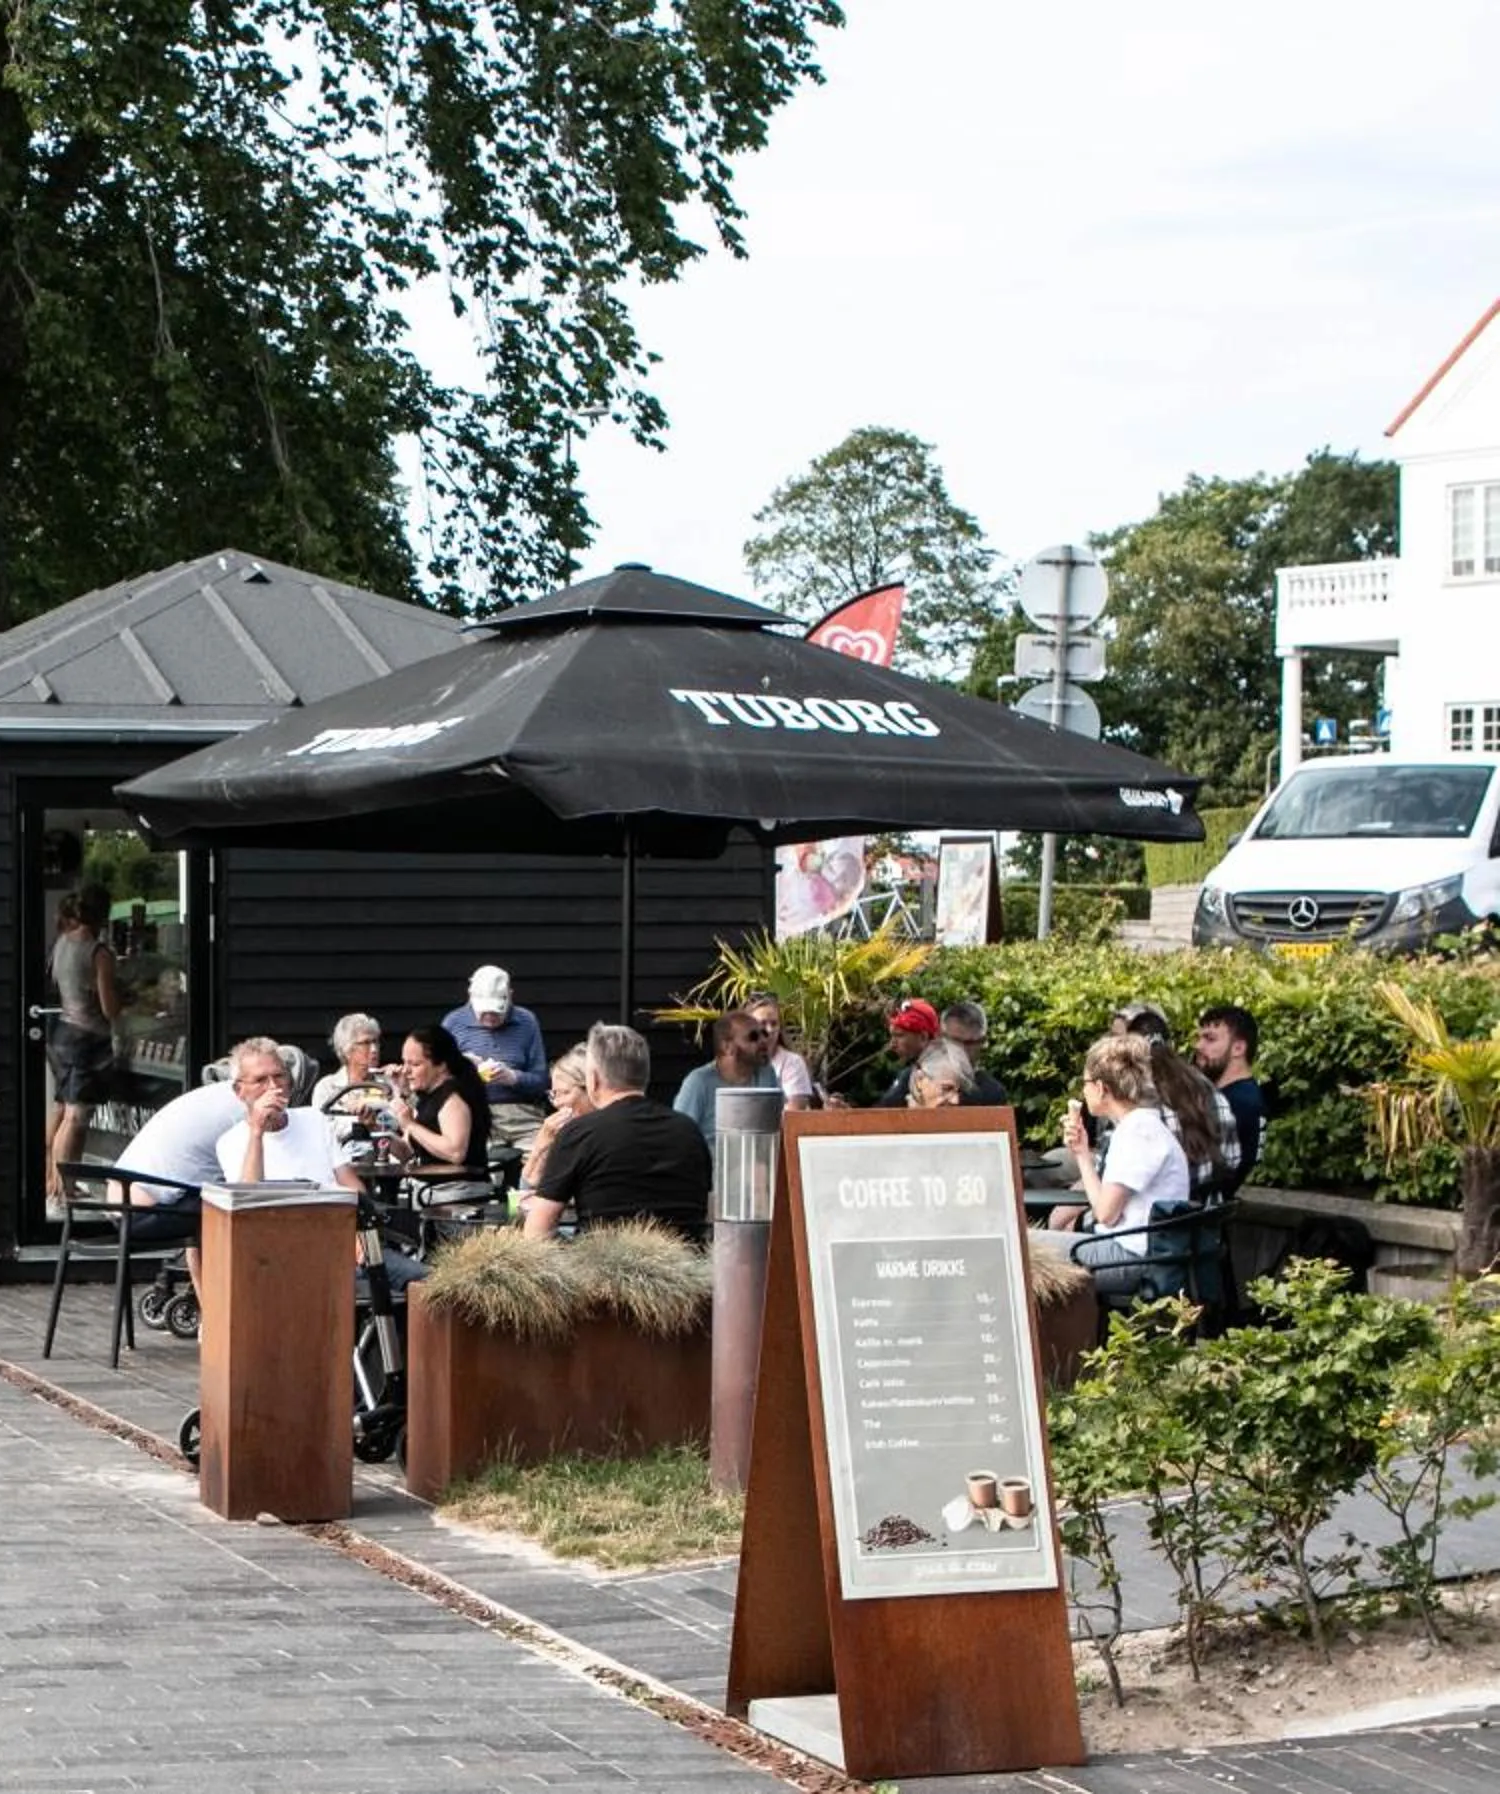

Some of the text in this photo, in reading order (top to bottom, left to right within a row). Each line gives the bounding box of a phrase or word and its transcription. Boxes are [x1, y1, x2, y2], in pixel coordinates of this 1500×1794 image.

[668, 688, 941, 737] TUBORG
[838, 1176, 913, 1209] COFFEE
[919, 1176, 947, 1207] TO
